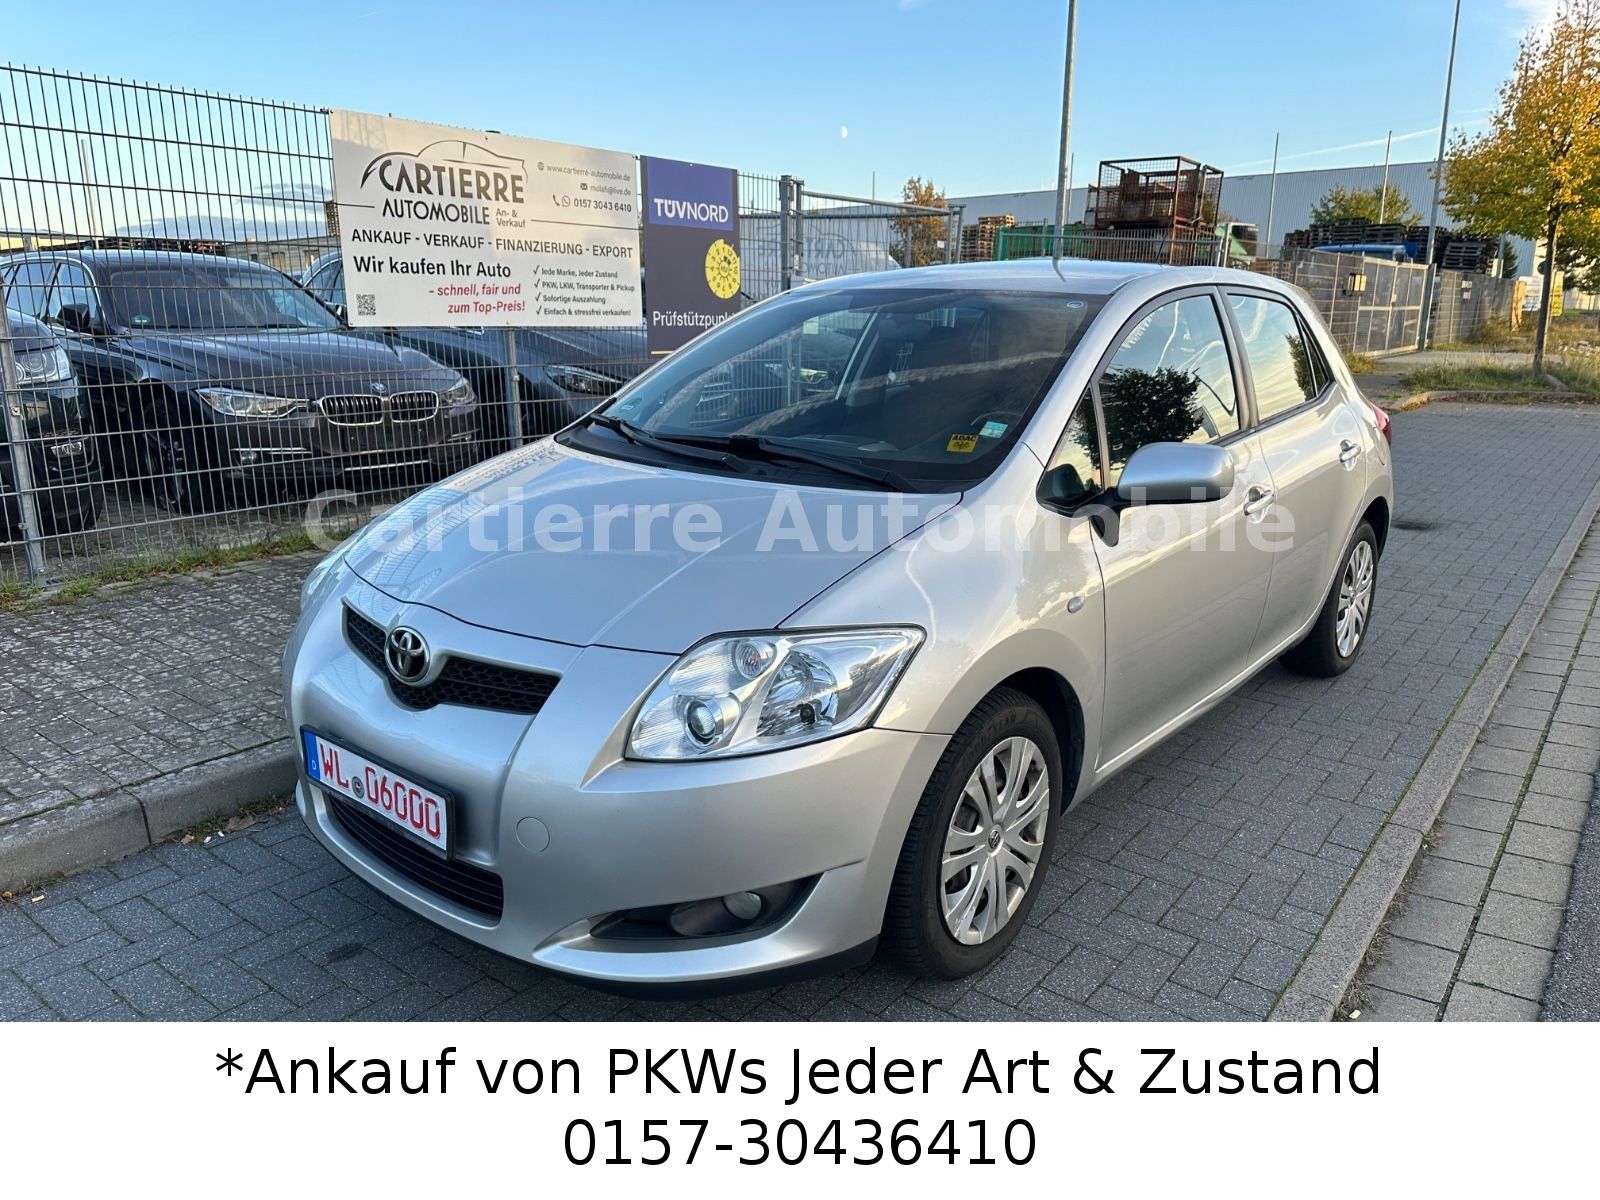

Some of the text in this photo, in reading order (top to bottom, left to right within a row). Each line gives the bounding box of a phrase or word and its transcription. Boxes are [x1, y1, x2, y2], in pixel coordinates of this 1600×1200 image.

[546, 164, 631, 182] www.cartierre-automobile.de
[379, 159, 525, 204] CARTIERRE
[382, 198, 490, 225] AUTOMOBILE
[573, 198, 632, 213] 0157 3043 6410
[496, 208, 519, 218] An- &
[496, 217, 526, 229] Verkauf
[352, 228, 412, 245] ANKAUF
[423, 233, 485, 249] VERKAUF
[495, 238, 583, 255] FINANZIERUNG
[592, 245, 633, 259] EXPORT
[353, 256, 512, 278] Wir kaufen Ihr Auto
[541, 268, 618, 279] Jede Marke, Jeder Zustand
[437, 284, 480, 297] schnell,
[481, 284, 499, 296] fair
[501, 284, 521, 295] und
[542, 281, 635, 294] PKW, LKW, Transporter & Pickup
[542, 294, 606, 305] Sofortige Auszahlung
[447, 301, 526, 315] zum Top-Preis!
[543, 308, 567, 316] Einfach
[568, 308, 573, 316] &
[574, 308, 601, 316] stressfrei
[319, 742, 441, 840] WL 06000
